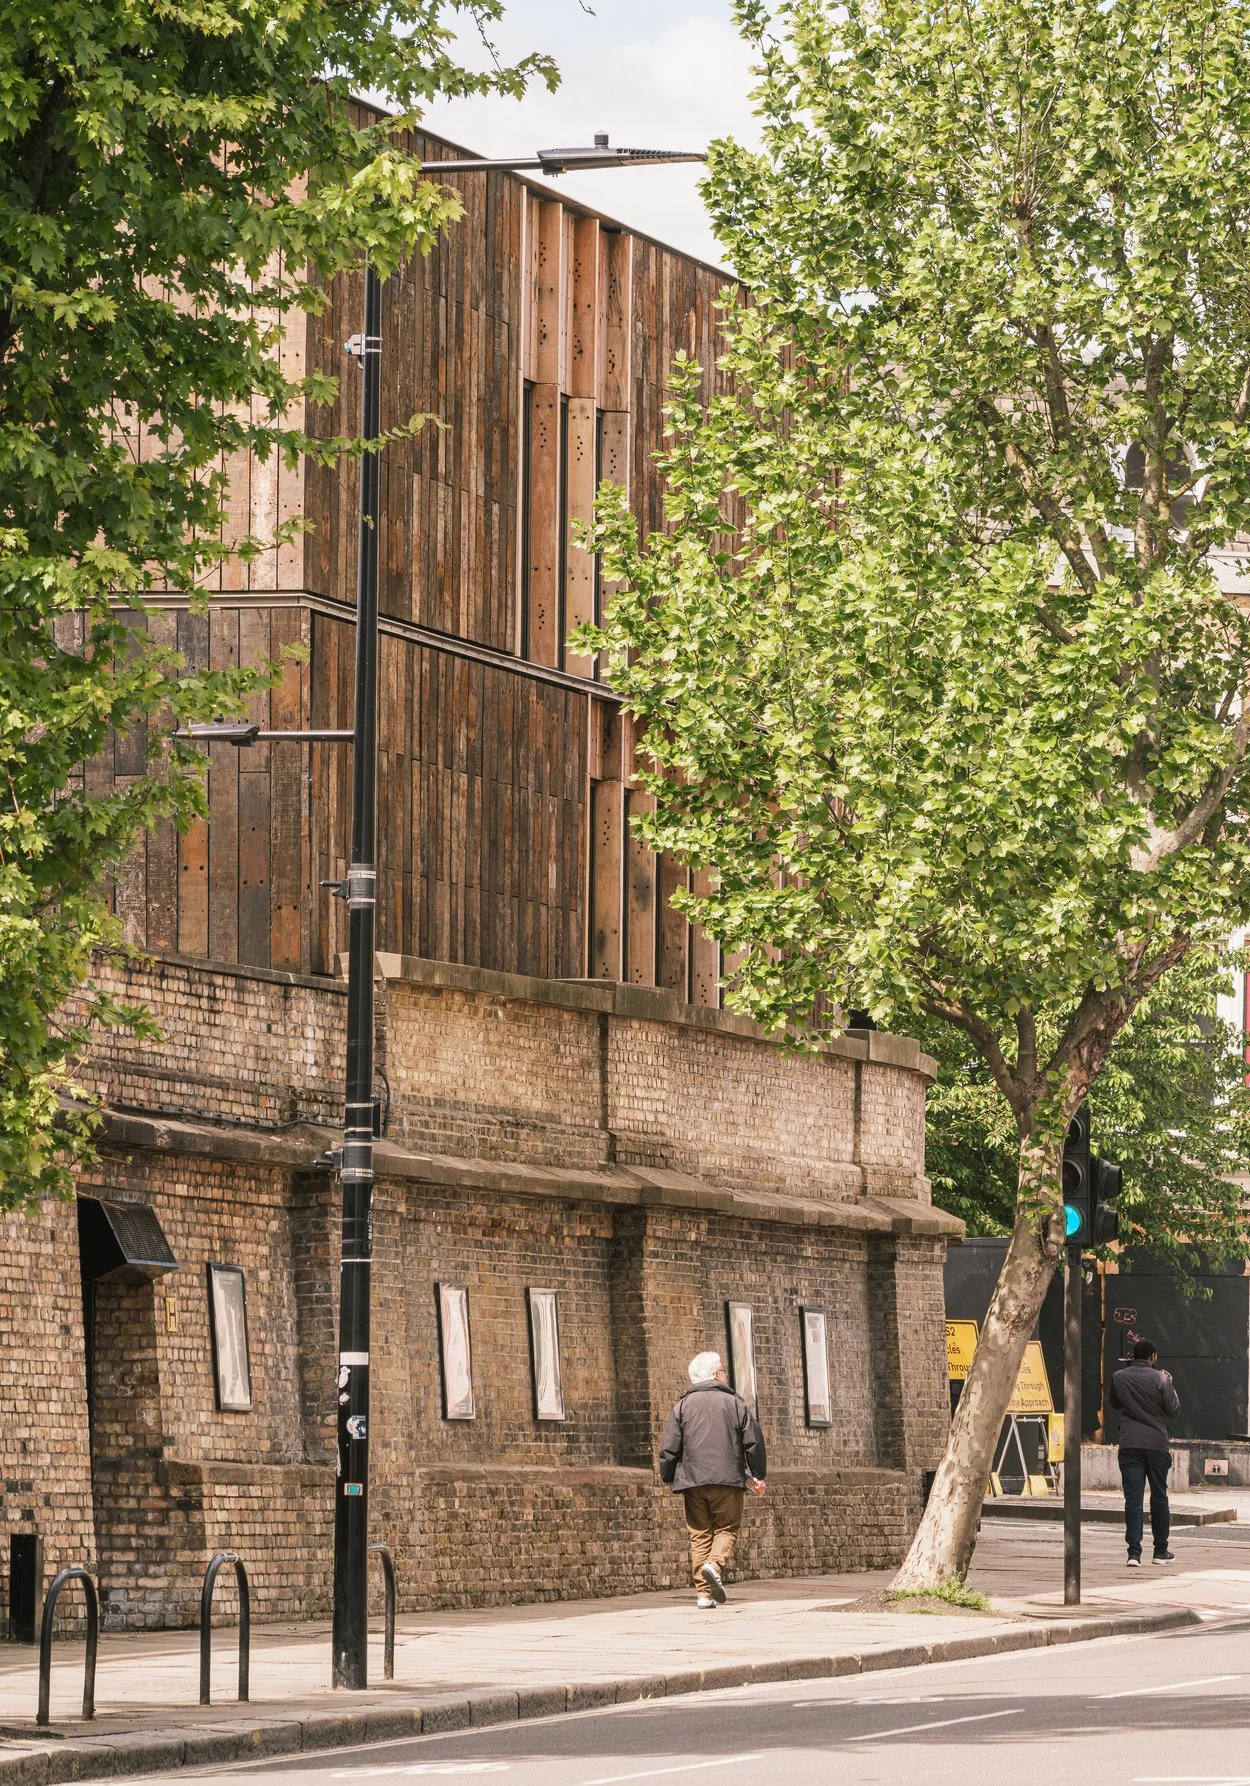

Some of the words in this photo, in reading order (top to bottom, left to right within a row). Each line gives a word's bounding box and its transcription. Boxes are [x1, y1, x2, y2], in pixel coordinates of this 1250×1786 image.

[945, 1326, 956, 1336] S2
[948, 1362, 970, 1371] Throu
[1020, 1381, 1044, 1392] Through
[1021, 1398, 1049, 1408] Approach
